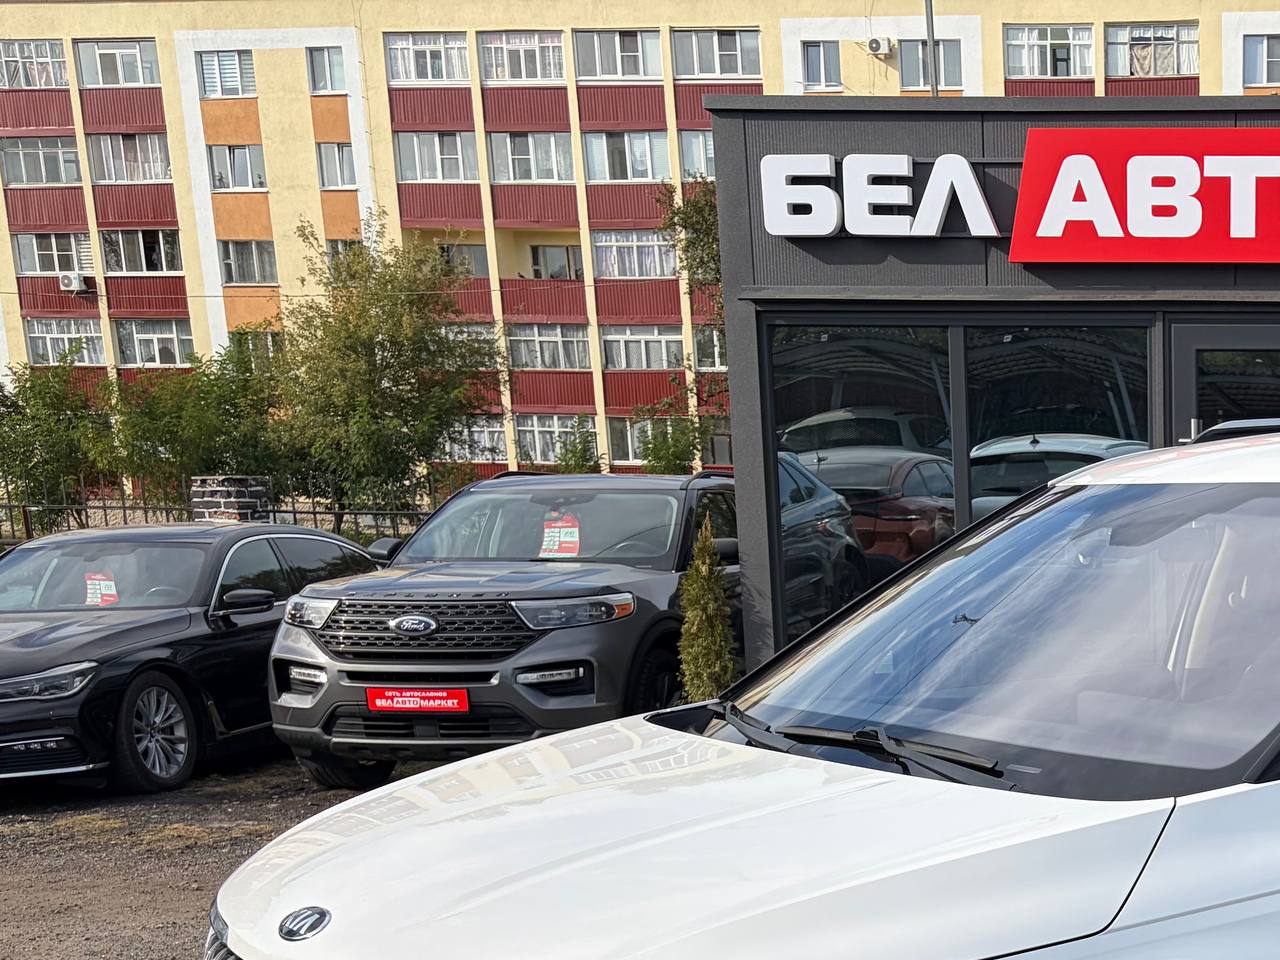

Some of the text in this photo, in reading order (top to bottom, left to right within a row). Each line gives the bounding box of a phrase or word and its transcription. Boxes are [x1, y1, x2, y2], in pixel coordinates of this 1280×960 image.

[760, 153, 1000, 237] БЕЛ
[400, 619, 425, 631] Ford
[375, 698, 393, 707] БЕЛ
[421, 699, 459, 707] МАРКЕТ
[282, 909, 320, 934] KIA
